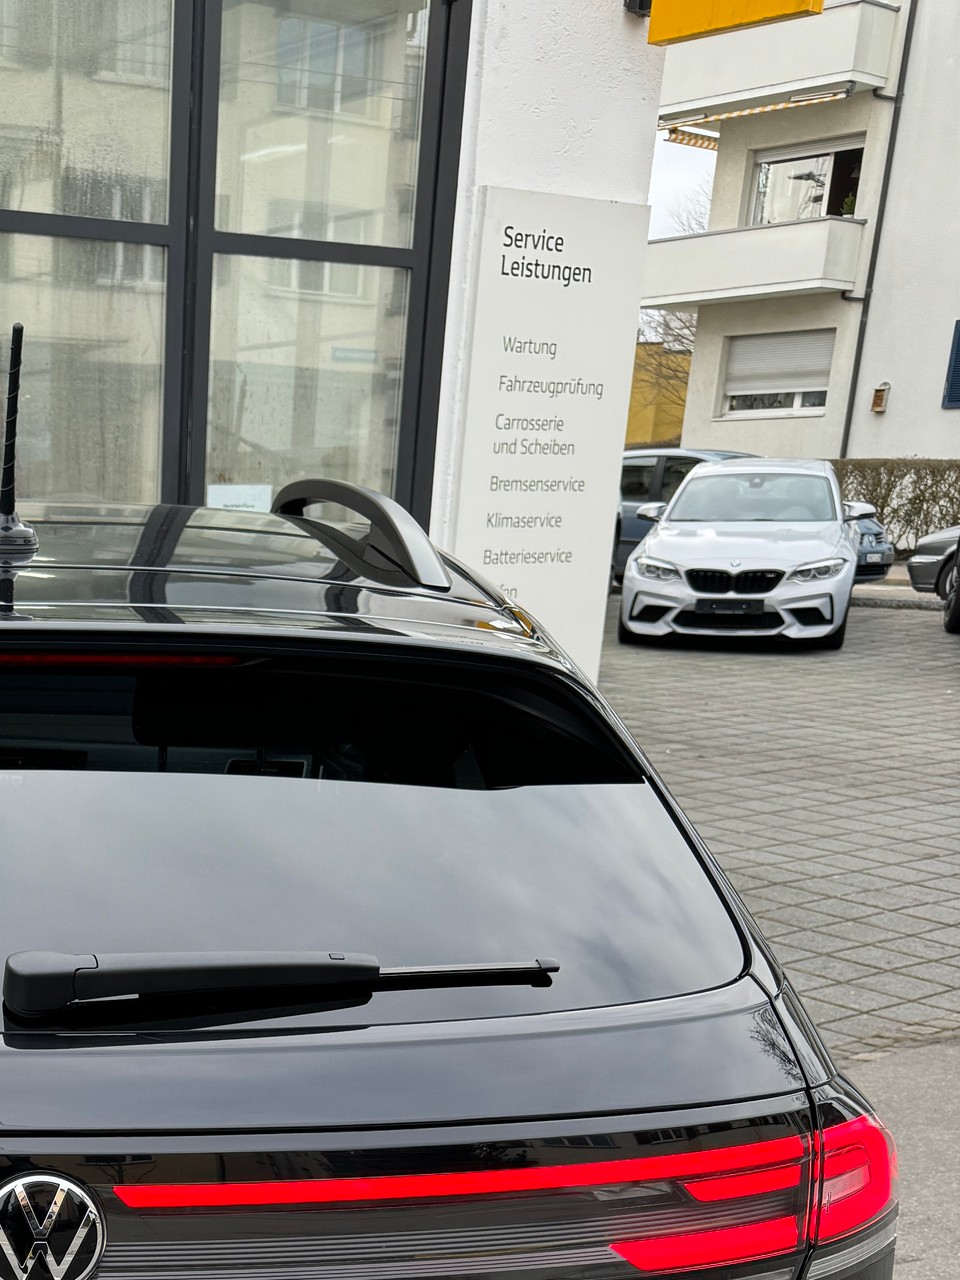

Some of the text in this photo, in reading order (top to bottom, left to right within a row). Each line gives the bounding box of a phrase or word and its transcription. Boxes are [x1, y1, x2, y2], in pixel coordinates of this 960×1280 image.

[503, 225, 565, 252] Service
[500, 254, 592, 287] Leistungen
[503, 336, 557, 360] Wartung
[498, 375, 604, 400] Fahrzeugprüfung
[495, 413, 564, 431] Carrosserie
[493, 438, 575, 456] und Scheiben
[489, 476, 585, 492] Bremsenservice
[486, 512, 562, 529] Klimaservice
[483, 548, 572, 565] Batterieservice
